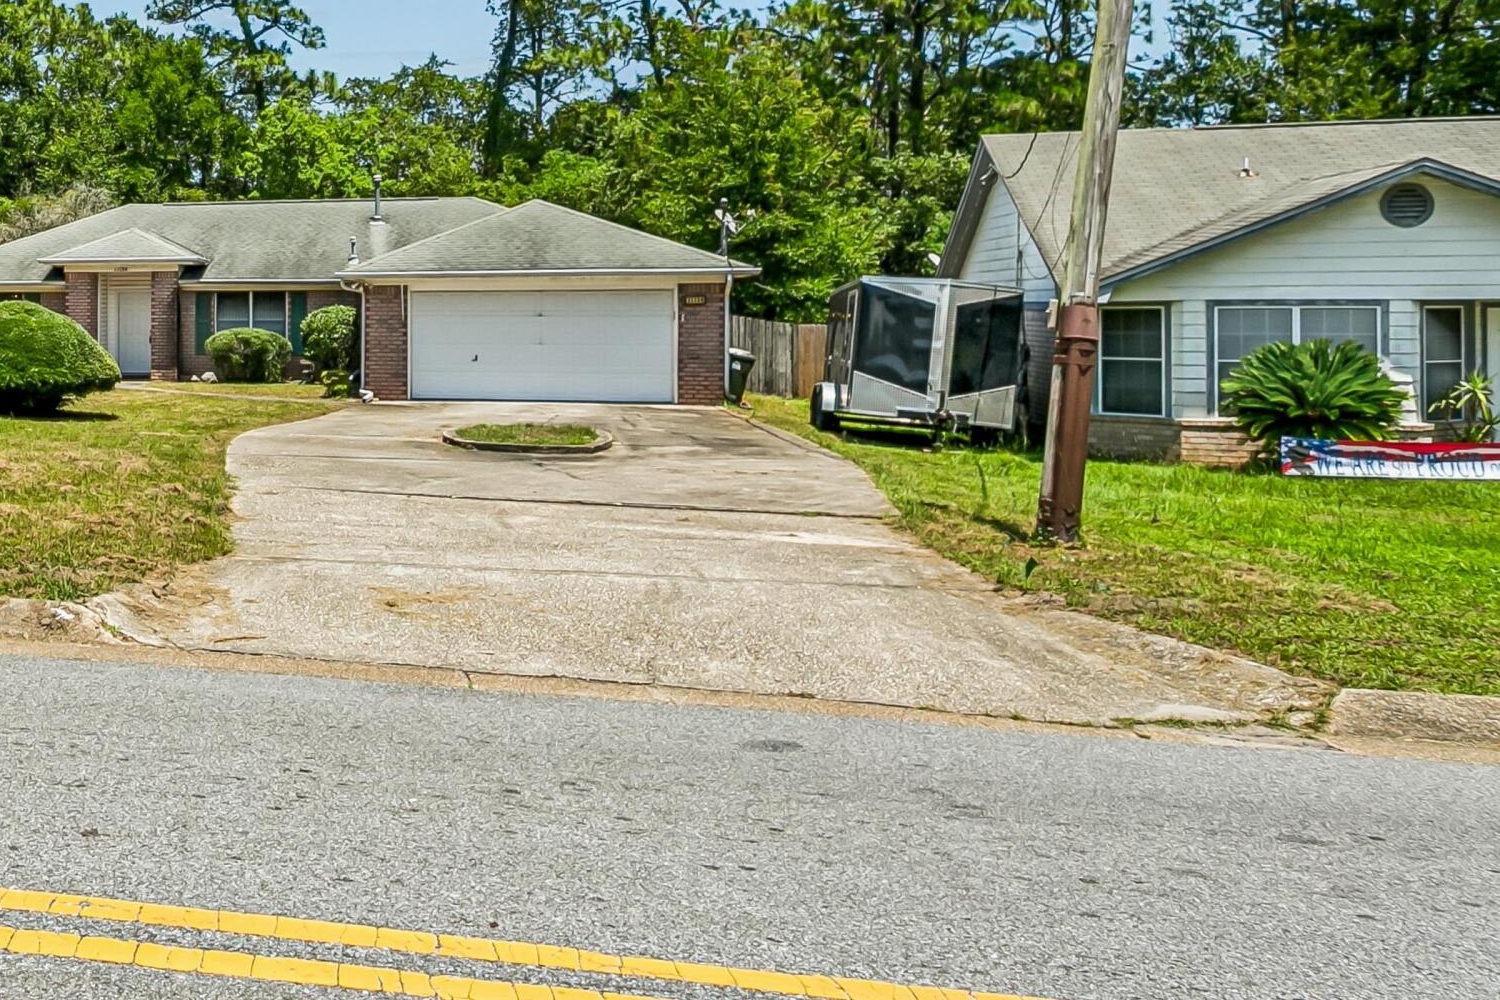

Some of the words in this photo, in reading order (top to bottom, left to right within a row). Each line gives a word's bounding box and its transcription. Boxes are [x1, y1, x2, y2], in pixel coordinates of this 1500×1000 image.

[1317, 456, 1345, 475] WE
[1353, 454, 1389, 476] ARE
[1414, 452, 1485, 477] PROUD
